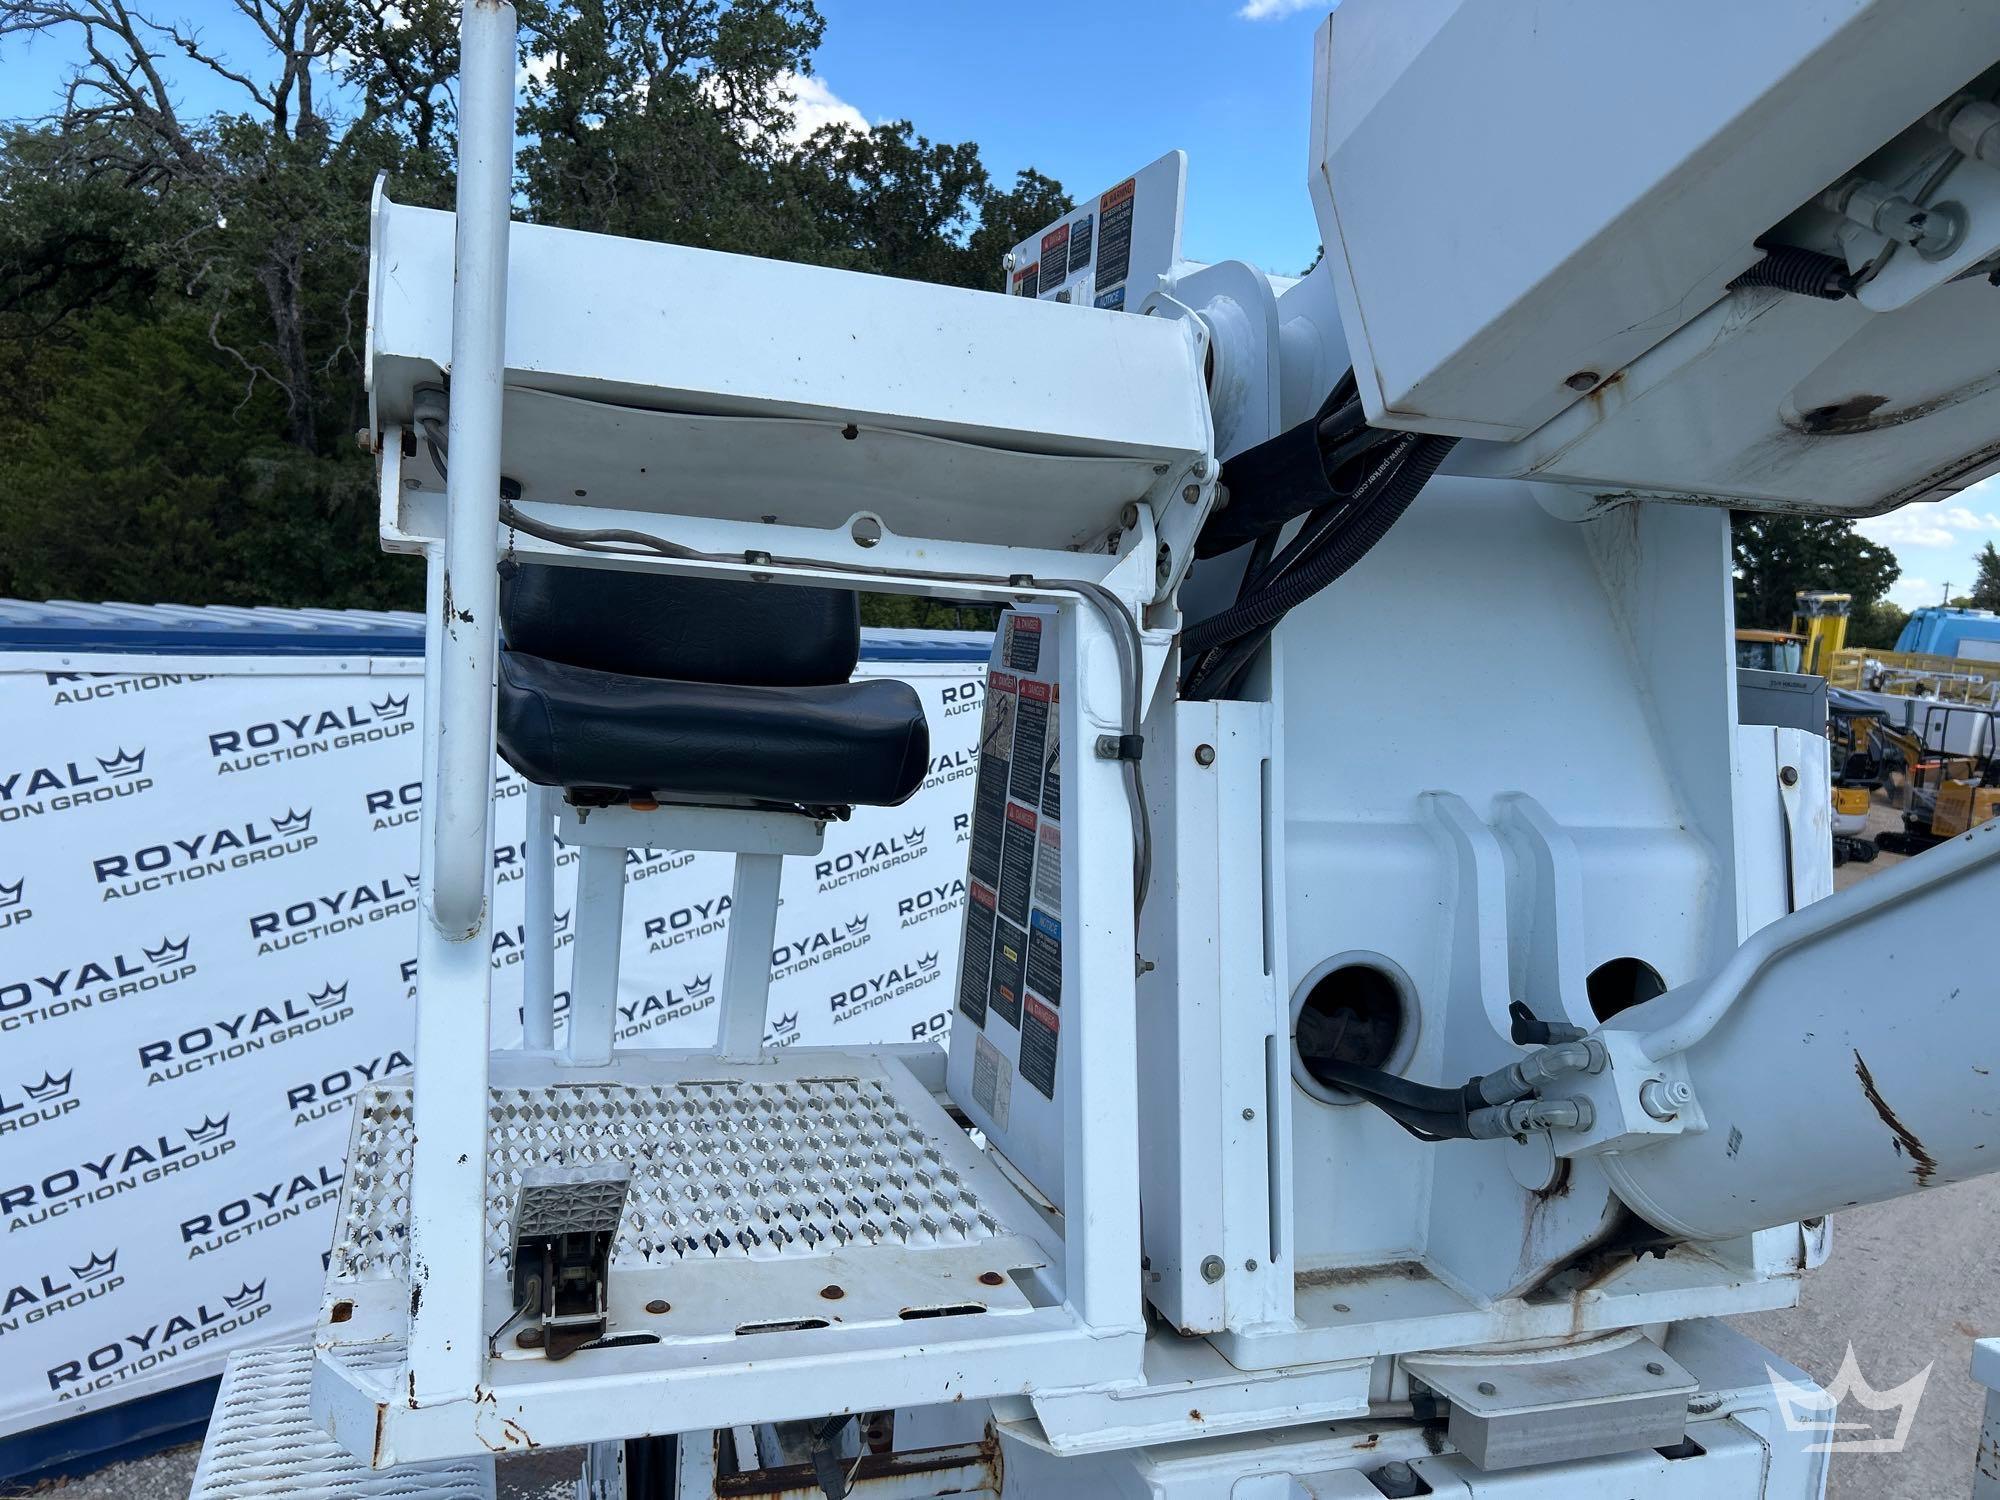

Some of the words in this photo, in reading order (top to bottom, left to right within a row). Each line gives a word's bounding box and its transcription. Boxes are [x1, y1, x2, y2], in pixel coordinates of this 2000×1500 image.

[1352, 441, 1408, 500] www.parker.com
[54, 673, 182, 706] AUCTION
[208, 706, 372, 757] ROYAL
[217, 740, 329, 776] AUCTION
[333, 721, 415, 749] GROUP
[0, 762, 99, 801] YAL
[51, 777, 154, 811] GROUP
[92, 823, 272, 883] ROYAL
[102, 860, 226, 902] AUCTION
[231, 835, 319, 868] GROUP
[633, 854, 696, 881] GROUP
[814, 837, 905, 881] ROYAL
[818, 865, 880, 894] AUCTION
[882, 846, 928, 870] GROUP
[249, 879, 406, 939] ROYAL
[644, 894, 732, 939] ROYA
[898, 878, 966, 917] ROYA
[901, 904, 957, 929] AUCTION
[257, 915, 364, 956] AUCTION
[369, 898, 417, 922] GRO
[649, 919, 726, 954] AUCTION
[772, 927, 846, 967] OYAL
[822, 934, 871, 961] GROUP
[0, 954, 144, 1012] OYAL
[0, 994, 93, 1032] CTION
[98, 964, 198, 1003] GROUP
[618, 989, 684, 1023] YAL
[830, 960, 919, 1012] ROYAL
[833, 990, 894, 1025] AUCTION
[895, 970, 942, 999] GROUP
[138, 998, 310, 1069] ROYAL
[655, 996, 716, 1026] GROUP
[147, 1037, 266, 1087] AUCTION
[269, 1006, 355, 1045] GROUP
[286, 1049, 413, 1110] ROYA
[0, 1098, 80, 1136] ROUP
[294, 1093, 356, 1127] AUCT
[0, 1136, 187, 1215] ROYAL
[9, 1176, 137, 1233] AUCTION
[143, 1139, 237, 1184] GROUP
[180, 1165, 343, 1243] ROYAL
[188, 1203, 300, 1260] AUCTION
[26, 1275, 125, 1323] GROUP
[47, 1304, 225, 1391] ROYAL
[59, 1345, 177, 1402] AUCTION
[183, 1303, 272, 1351] GROUP
